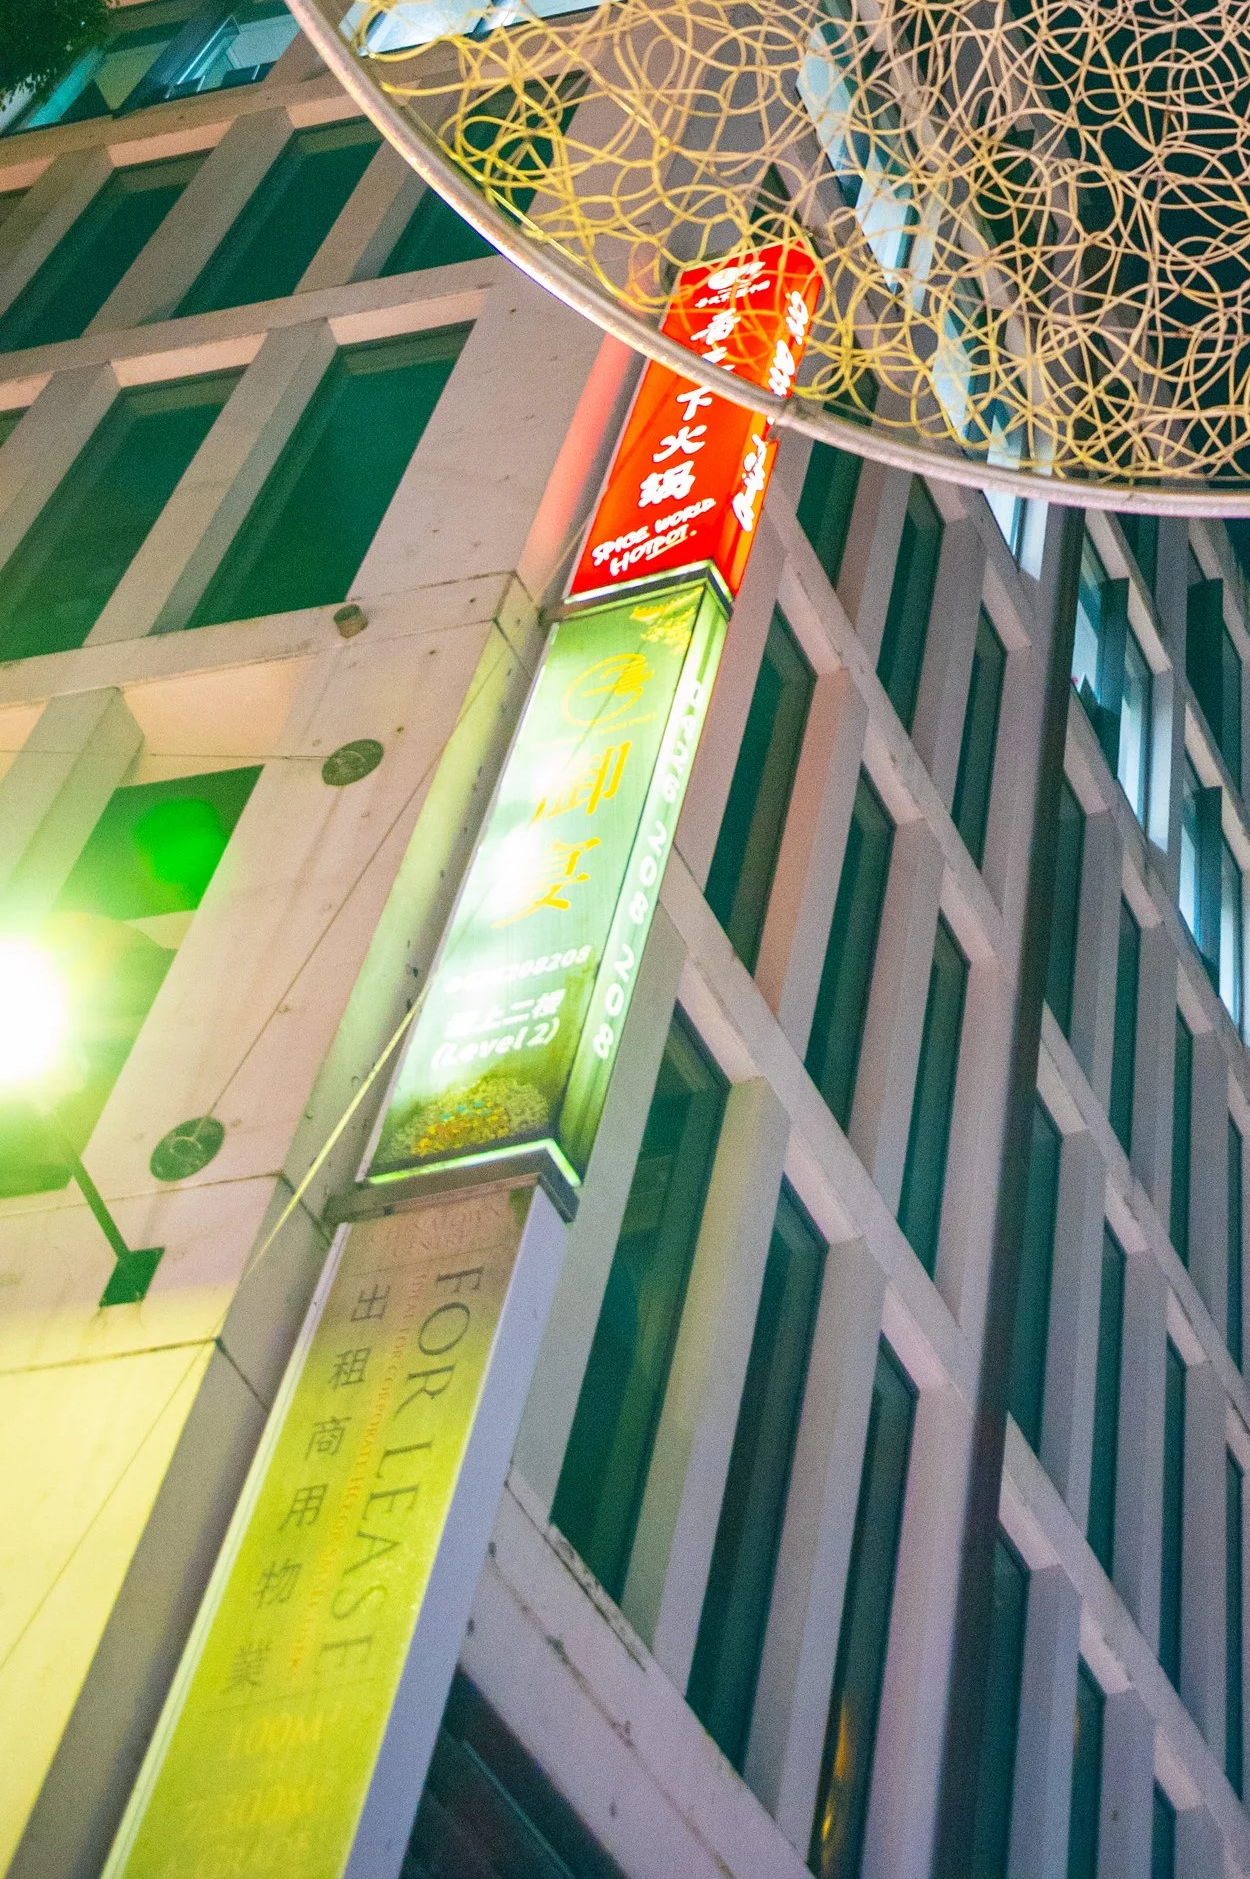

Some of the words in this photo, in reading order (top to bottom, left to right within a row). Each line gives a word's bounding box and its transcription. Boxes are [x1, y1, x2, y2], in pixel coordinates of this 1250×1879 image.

[592, 525, 650, 566] SPICE
[654, 498, 717, 533] WORLD
[527, 1017, 560, 1047] 2)
[592, 943, 636, 1062] 208
[394, 1264, 485, 1420] FOR
[225, 1283, 391, 1696] 出租商用物業
[317, 1439, 434, 1678] LEASE
